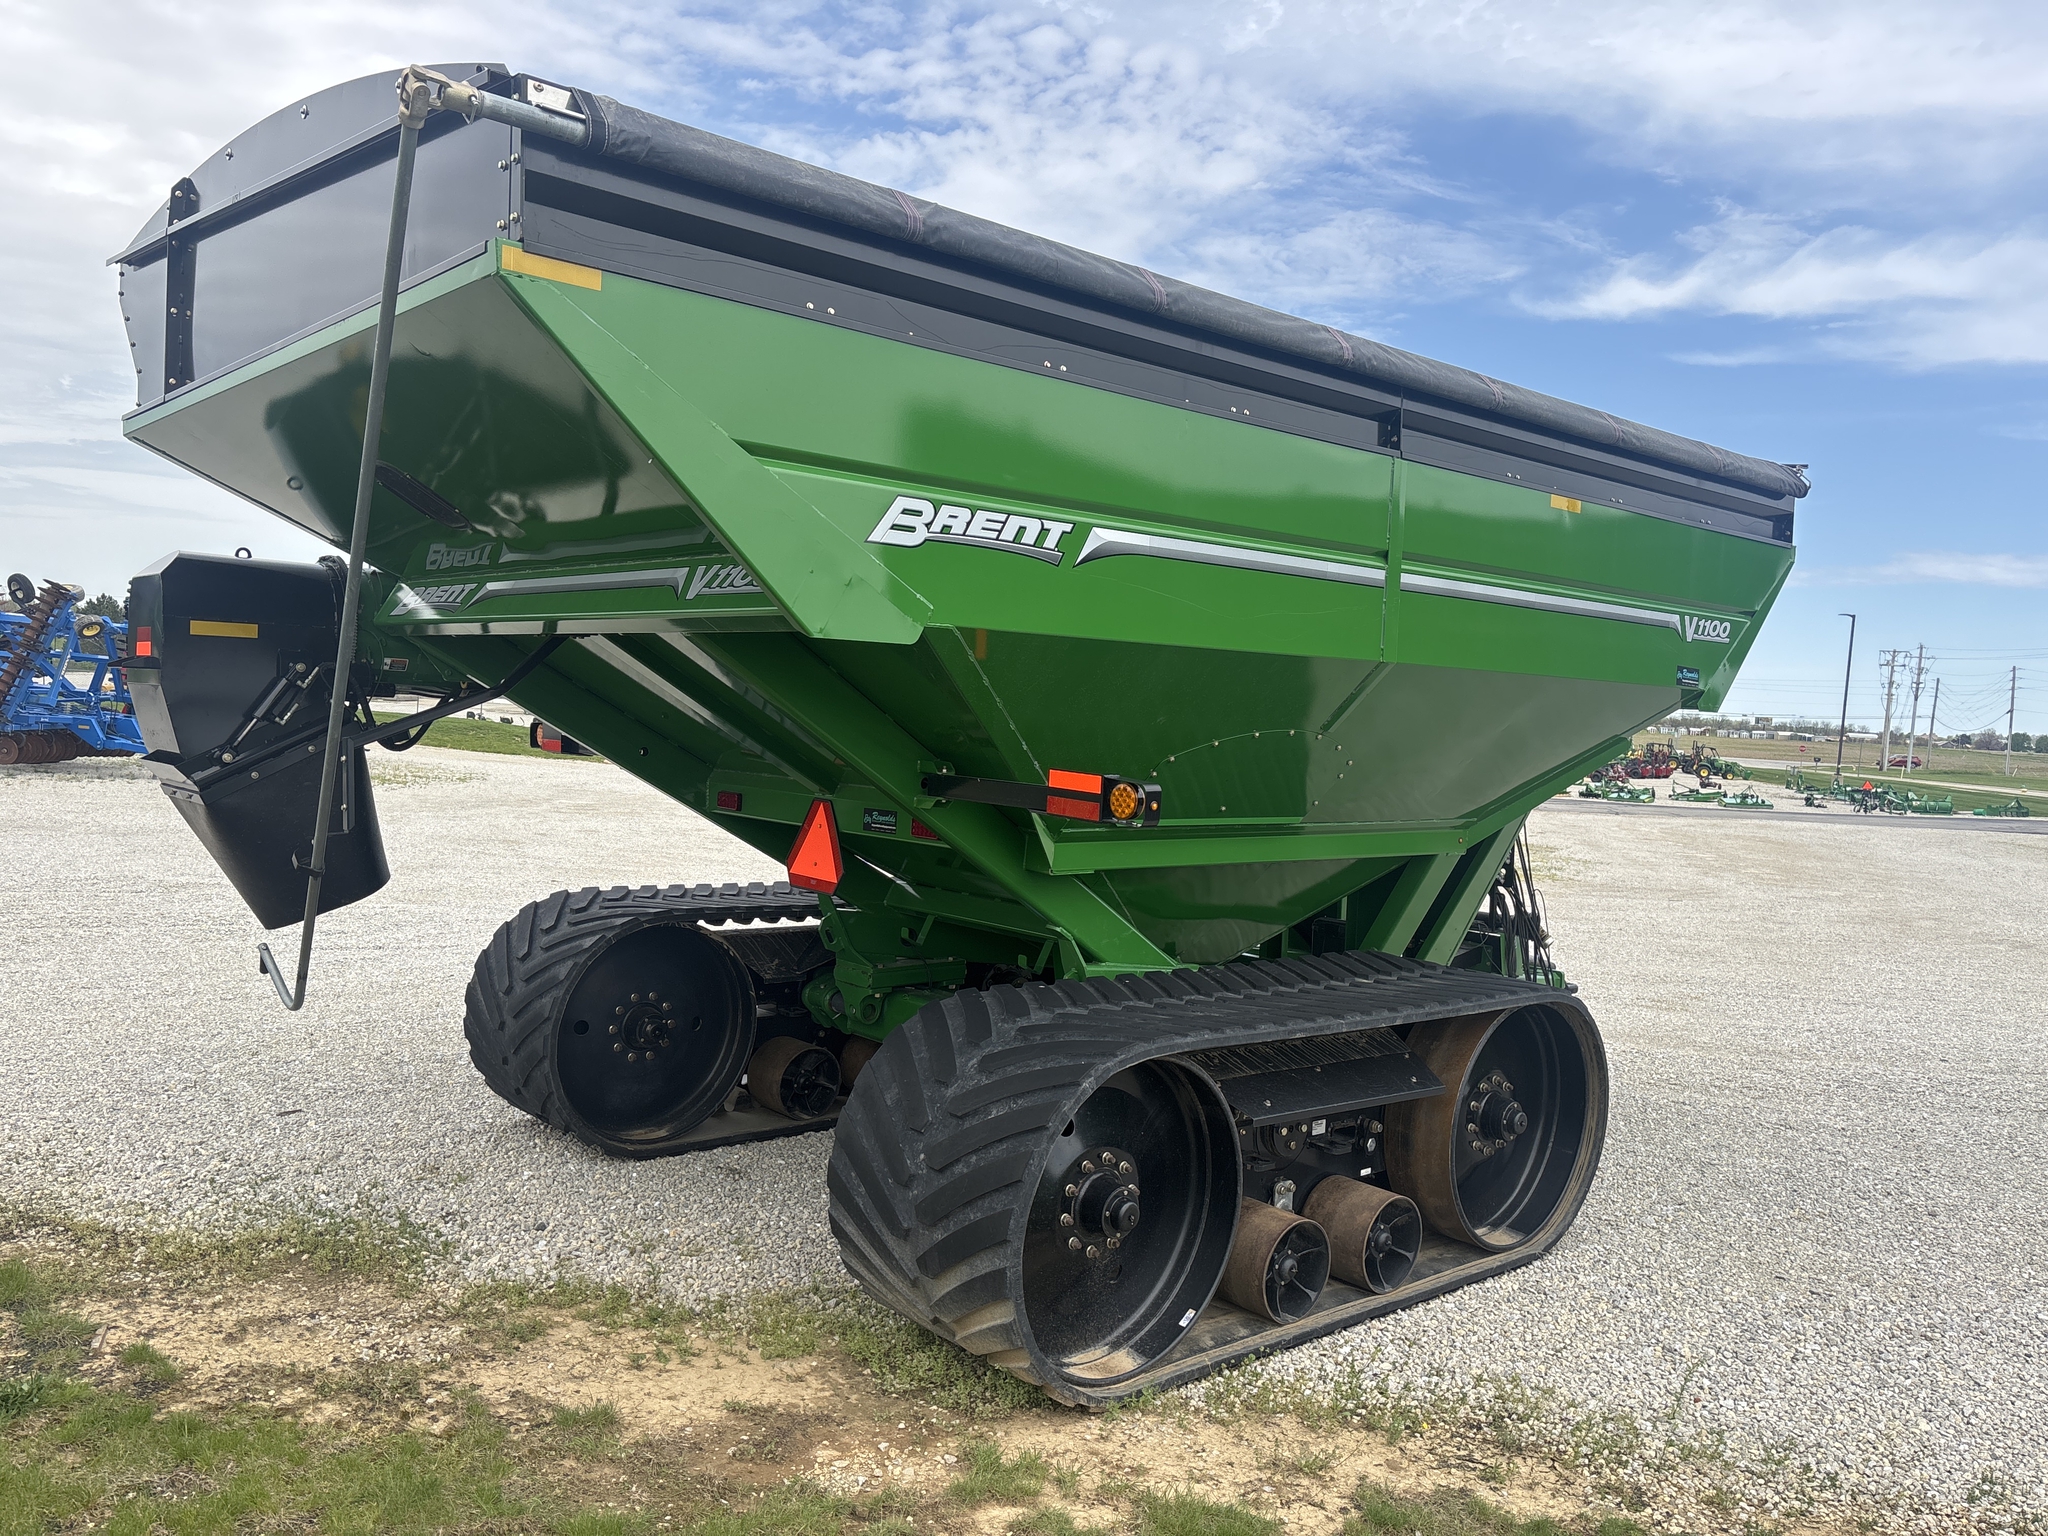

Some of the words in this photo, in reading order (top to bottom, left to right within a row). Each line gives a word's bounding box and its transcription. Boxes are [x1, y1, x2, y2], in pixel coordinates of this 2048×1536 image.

[865, 495, 1076, 551] BRENT
[685, 564, 758, 600] V110
[1684, 615, 1731, 643] V1100
